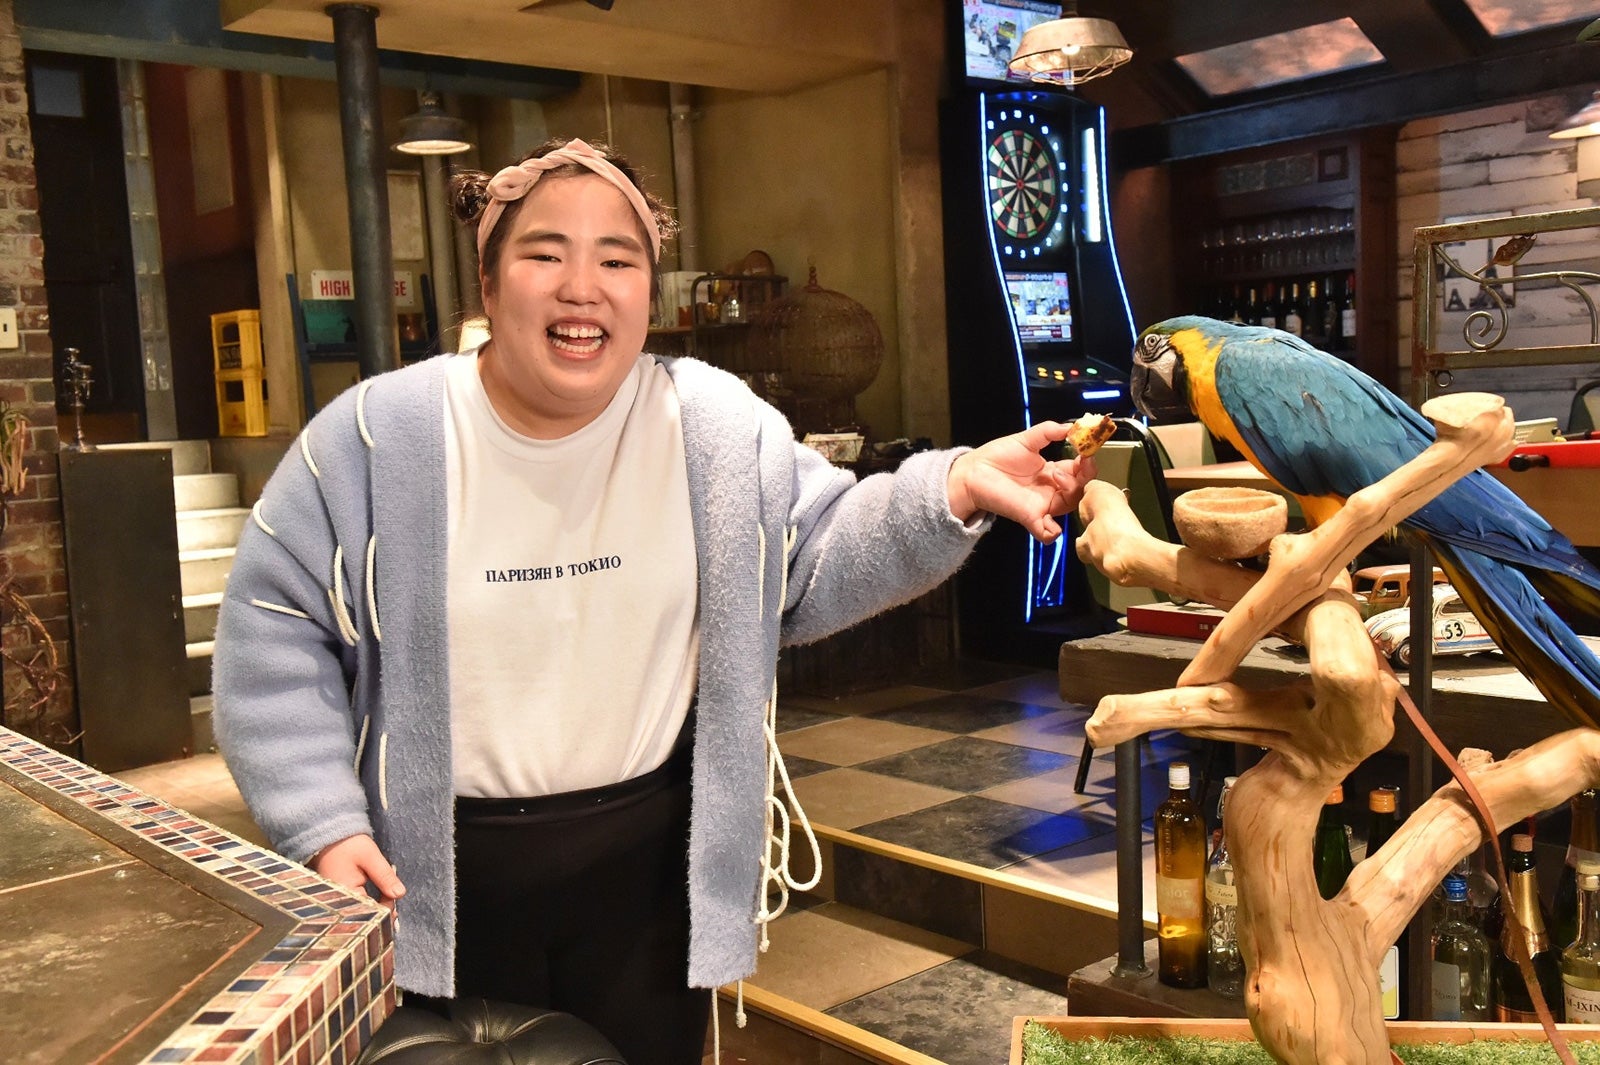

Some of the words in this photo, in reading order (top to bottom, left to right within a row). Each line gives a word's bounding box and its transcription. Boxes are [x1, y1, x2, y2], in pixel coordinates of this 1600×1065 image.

[320, 280, 351, 296] HIGH
[485, 567, 552, 582] ПАРИЗЯН
[555, 565, 564, 578] В
[567, 555, 622, 577] ТОКИО
[1445, 622, 1463, 639] 53
